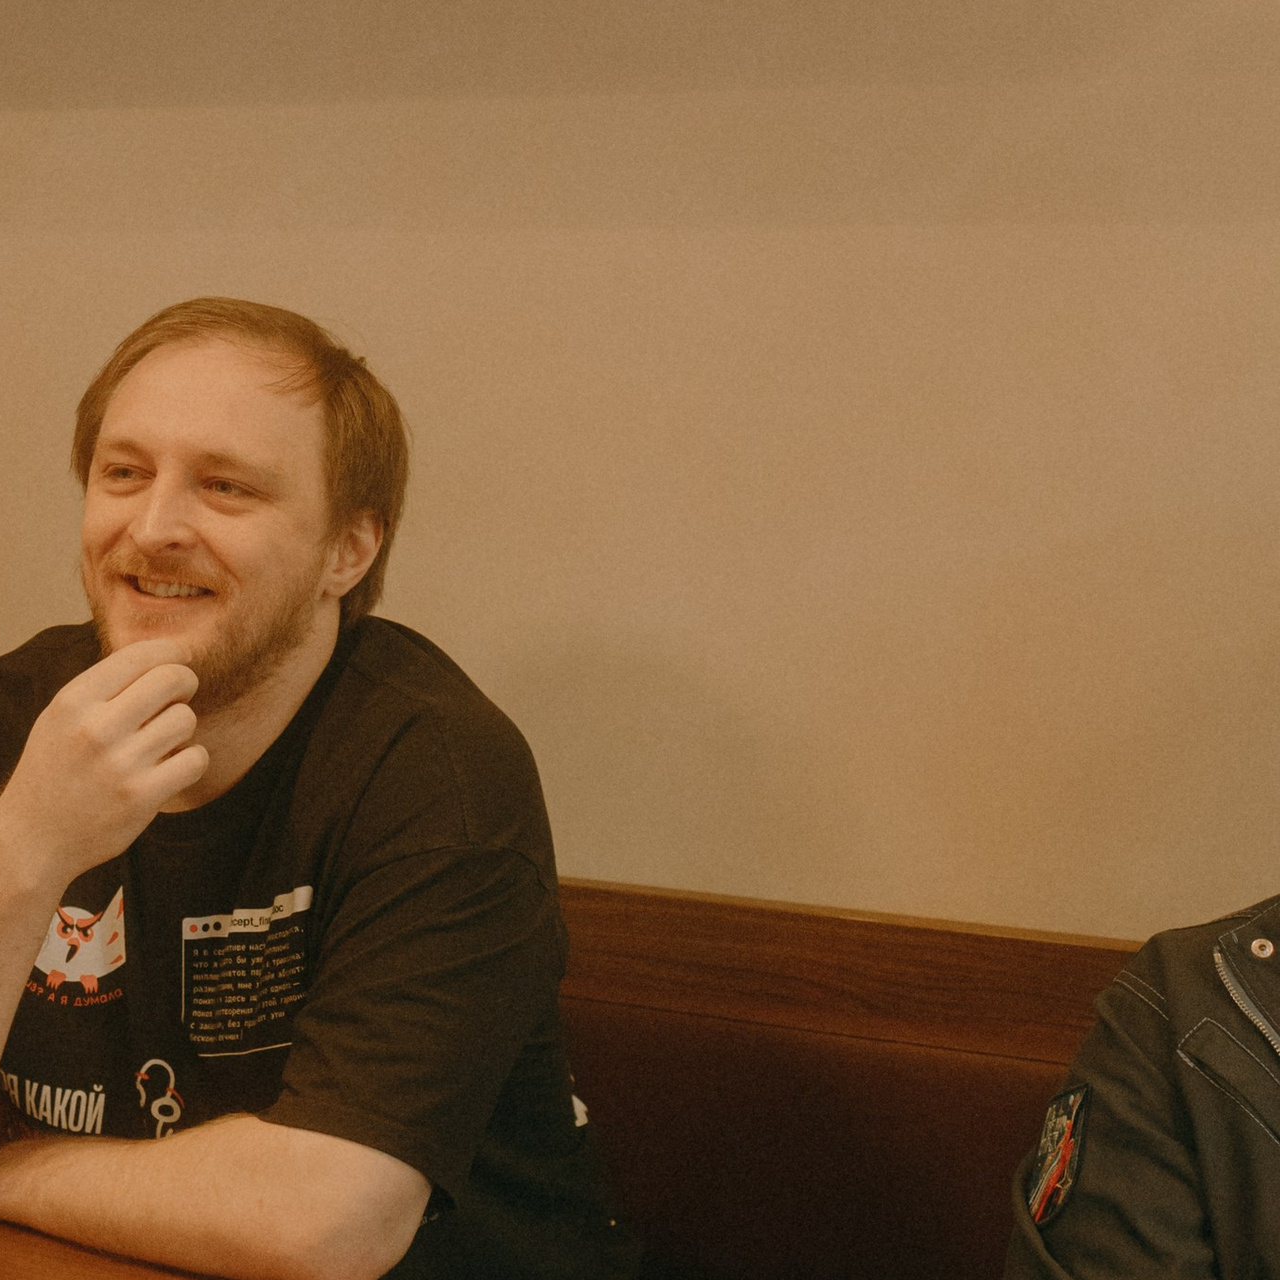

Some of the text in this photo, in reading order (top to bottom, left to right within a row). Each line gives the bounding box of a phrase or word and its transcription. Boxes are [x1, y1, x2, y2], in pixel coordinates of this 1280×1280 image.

[47, 992, 56, 1002] А
[60, 996, 68, 1006] Я
[24, 1079, 106, 1135] КАКОЙ
